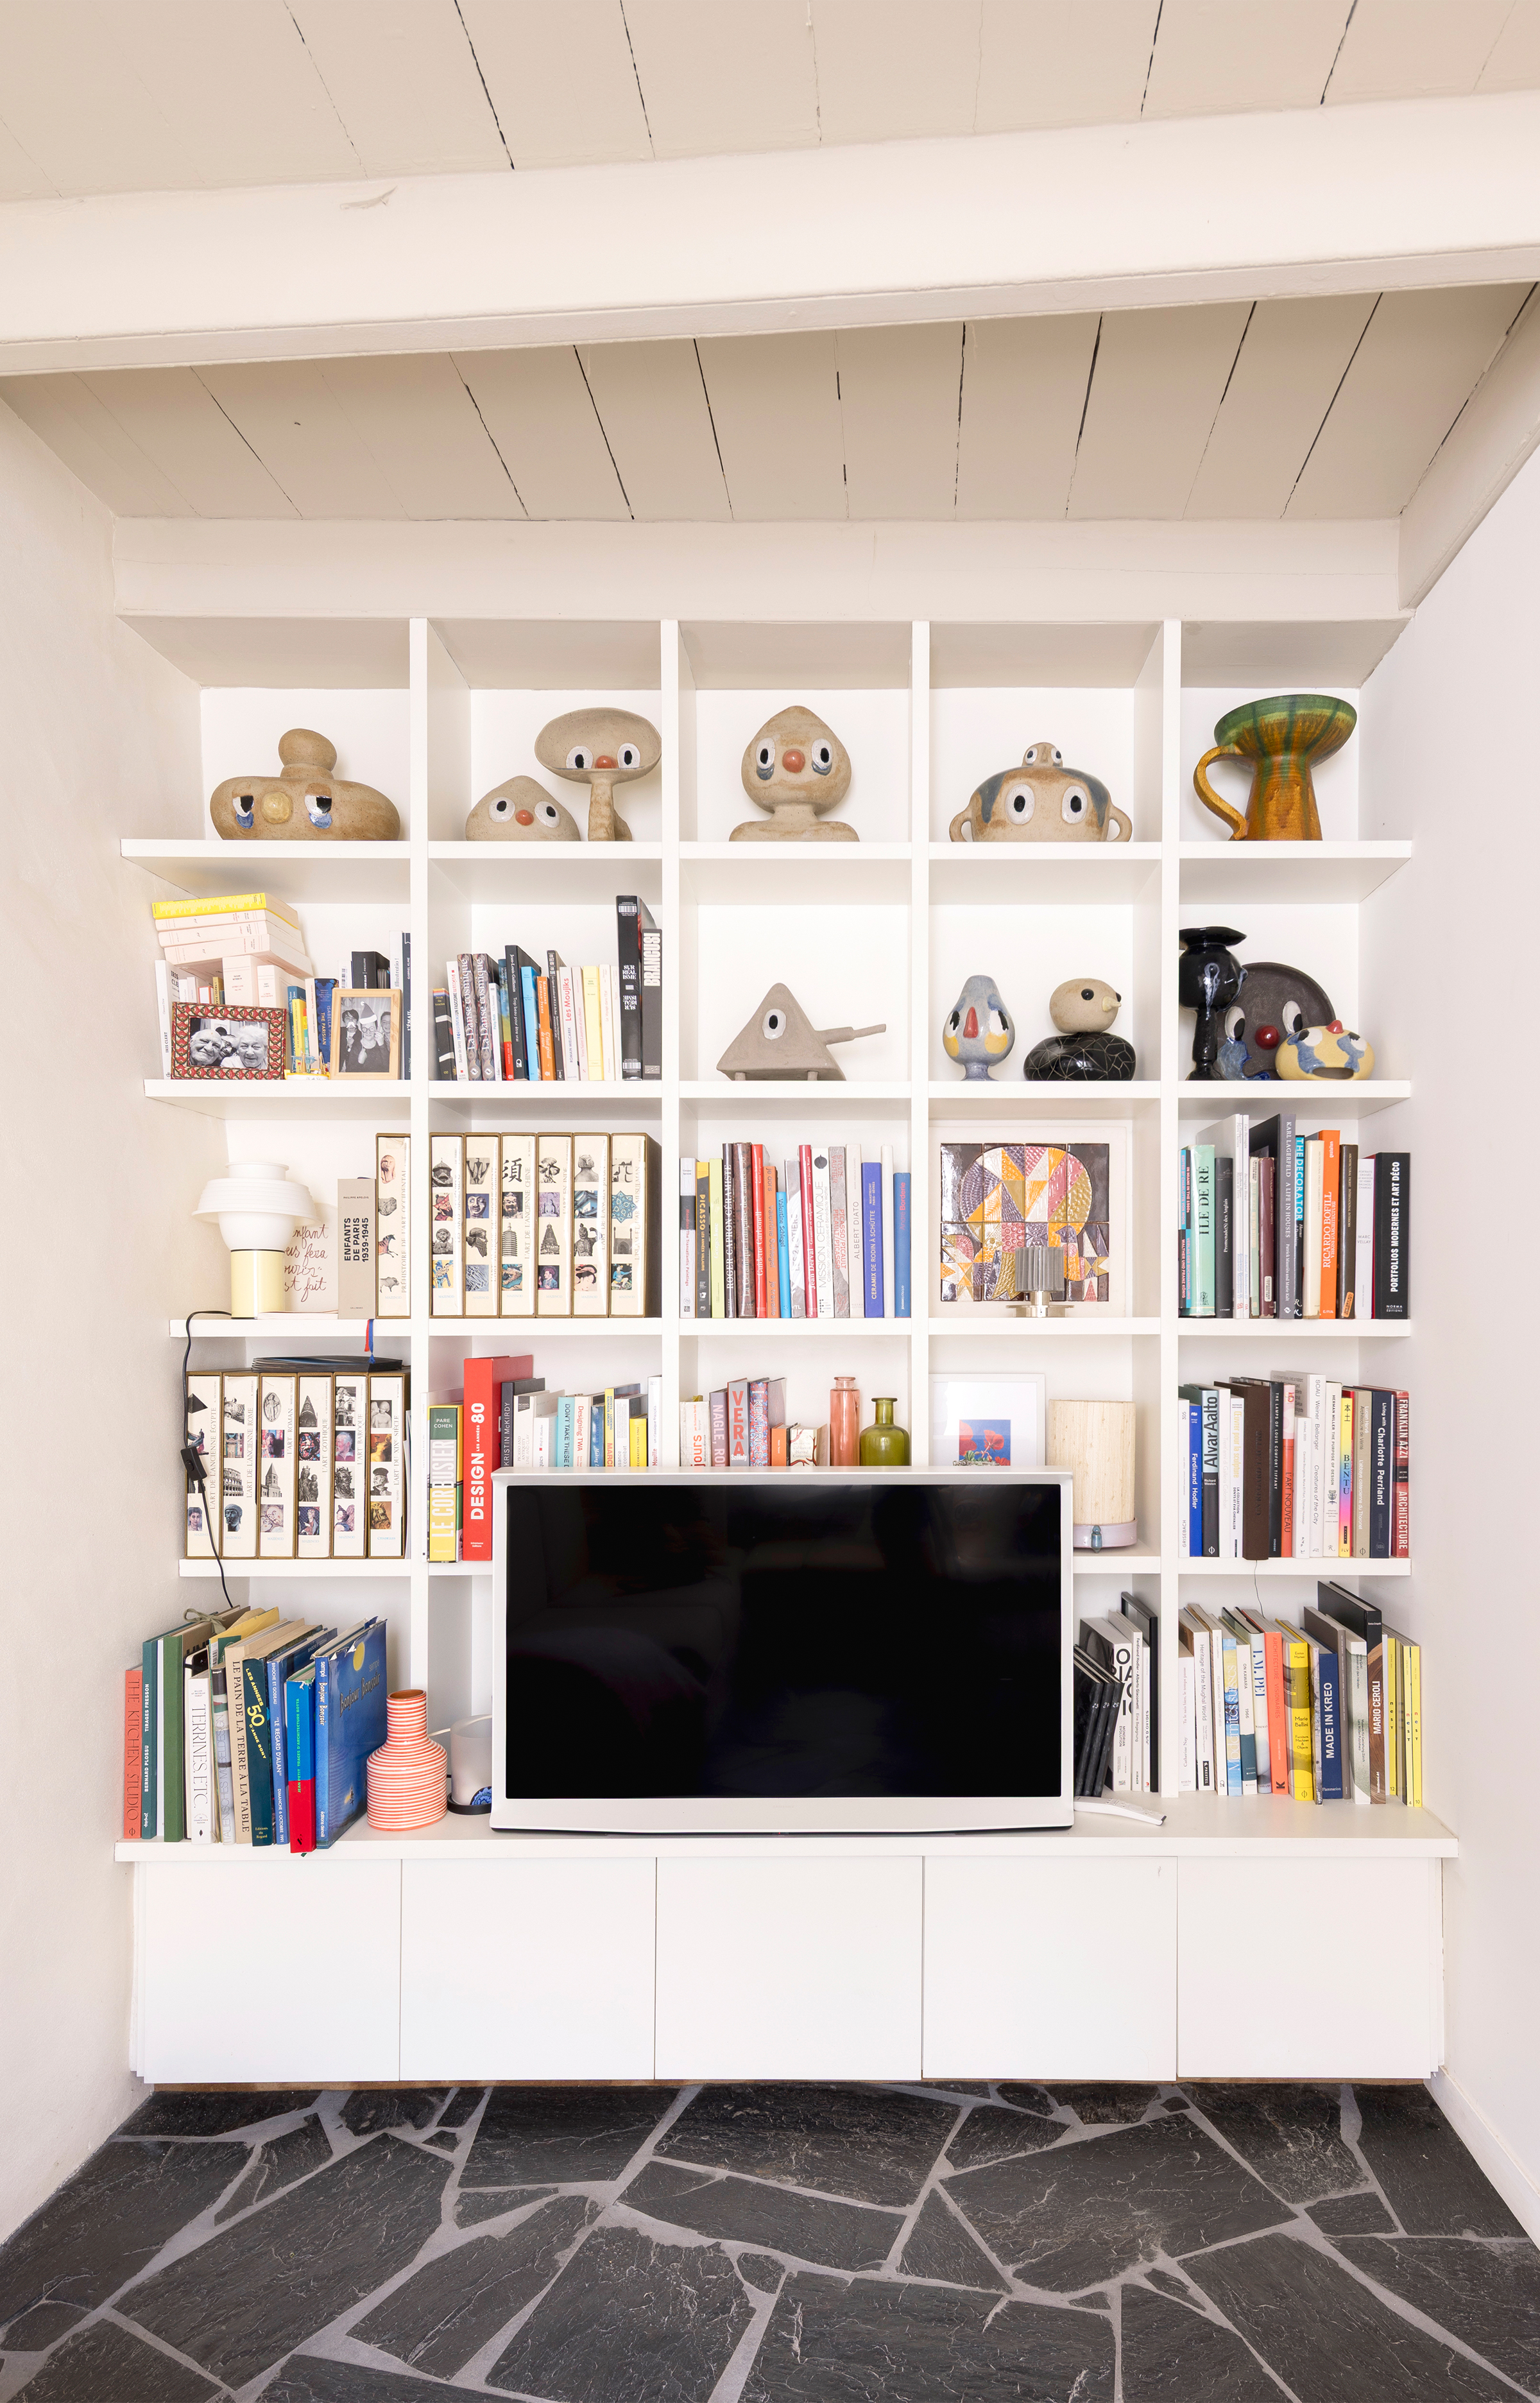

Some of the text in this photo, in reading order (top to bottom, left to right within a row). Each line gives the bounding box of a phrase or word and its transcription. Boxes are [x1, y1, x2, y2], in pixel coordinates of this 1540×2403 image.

[644, 933, 660, 986] BRANCUSI
[462, 959, 475, 1049] La Danse cosmique
[477, 959, 490, 1049] La Danse cosmique
[724, 1164, 733, 1216] CÉRAMISTE
[1296, 1159, 1304, 1220] DECORATOR
[1390, 1162, 1400, 1181] DÉCO
[1391, 1182, 1399, 1196] ART
[1199, 1189, 1210, 1206] DE
[1323, 1192, 1332, 1225] BOFILL
[725, 1219, 733, 1255] CAPRON
[815, 1182, 826, 1288] MISSION CERAMIQUE
[1199, 1212, 1210, 1235] ILE
[1391, 1208, 1399, 1246] MODERNES
[354, 1249, 360, 1261] DE
[1390, 1248, 1399, 1292] PORTFOLIOS
[209, 1408, 217, 1433] ÉGYPTE
[471, 1403, 484, 1424] 80
[576, 1406, 585, 1436] Designing
[713, 1404, 724, 1444] NAGLE,
[732, 1391, 744, 1455] VERA
[754, 1399, 764, 1458] KEN PRICE
[1204, 1397, 1219, 1468] Alvar Aalto
[1399, 1399, 1408, 1458] FRANKLIN AZZI
[210, 1479, 216, 1488] DE
[431, 1440, 455, 1537] LE CORBUSIER
[471, 1453, 484, 1520] DESIGN
[1399, 1491, 1408, 1549] ARCHITECTURE
[232, 1661, 241, 1673] LE
[245, 1667, 254, 1680] LES
[234, 1676, 242, 1700] PAIN
[319, 1682, 327, 1703] Bonjour
[340, 1673, 381, 1717] Bonjour Bonsoir
[235, 1704, 243, 1716] DE
[237, 1719, 244, 1733] LA
[246, 1705, 265, 1727] 50
[319, 1705, 327, 1725] Bonsoir
[1226, 1665, 1240, 1771] Modernités suisses
[1323, 1682, 1335, 1759] MADE IN KREO
[1372, 1681, 1382, 1734] MARIO CEROLI
[126, 1679, 140, 1821] THE KITCHEN STUDIO
[192, 1704, 208, 1808] TERRINES, ETC.
[237, 1736, 246, 1769] TERRE
[240, 1784, 248, 1796] LA
